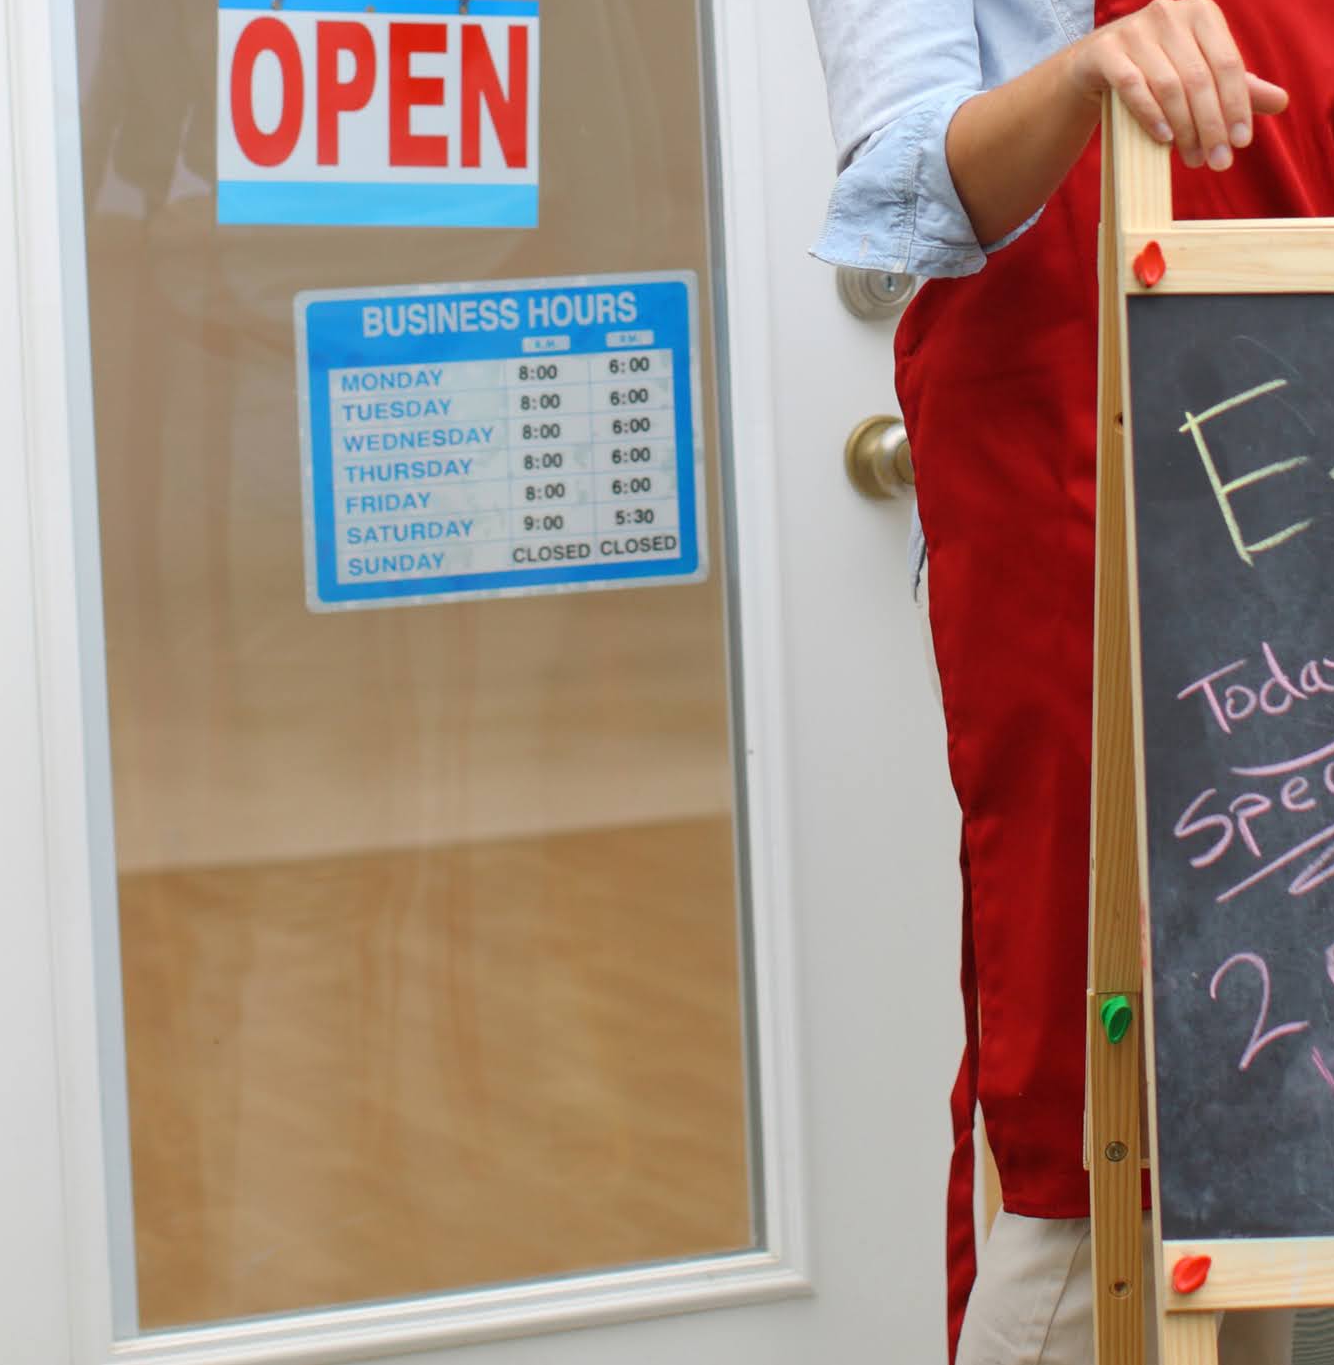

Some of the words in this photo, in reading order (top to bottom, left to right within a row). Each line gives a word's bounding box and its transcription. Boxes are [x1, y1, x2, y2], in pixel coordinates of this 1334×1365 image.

[229, 16, 528, 169] OPEN
[362, 297, 520, 338] BUSINESS
[528, 291, 638, 328] HOURS
[341, 369, 443, 392] MONDAY
[518, 364, 558, 381] 8:00
[609, 356, 650, 374] 6:00
[343, 398, 452, 421] TUESDAY
[520, 393, 560, 411] 8:00
[610, 388, 649, 406] 6:00
[344, 427, 494, 452] WEDNESDAY
[522, 423, 560, 440] 8:00
[612, 417, 651, 434] 6:00
[345, 457, 473, 483] THURSDAY
[524, 452, 563, 470] 8:00
[611, 446, 651, 464] 6:00
[346, 491, 431, 514] FRIDAY
[525, 483, 565, 501] 8:00
[612, 477, 651, 495] 6:00
[347, 519, 474, 545] SATURDAY
[523, 515, 564, 531] 9:00
[615, 508, 655, 525] 5:30
[348, 552, 445, 576] SUNDAY
[512, 542, 591, 563] CLOSED
[600, 535, 677, 556] CLOSED
[1209, 952, 1310, 1071] 2
